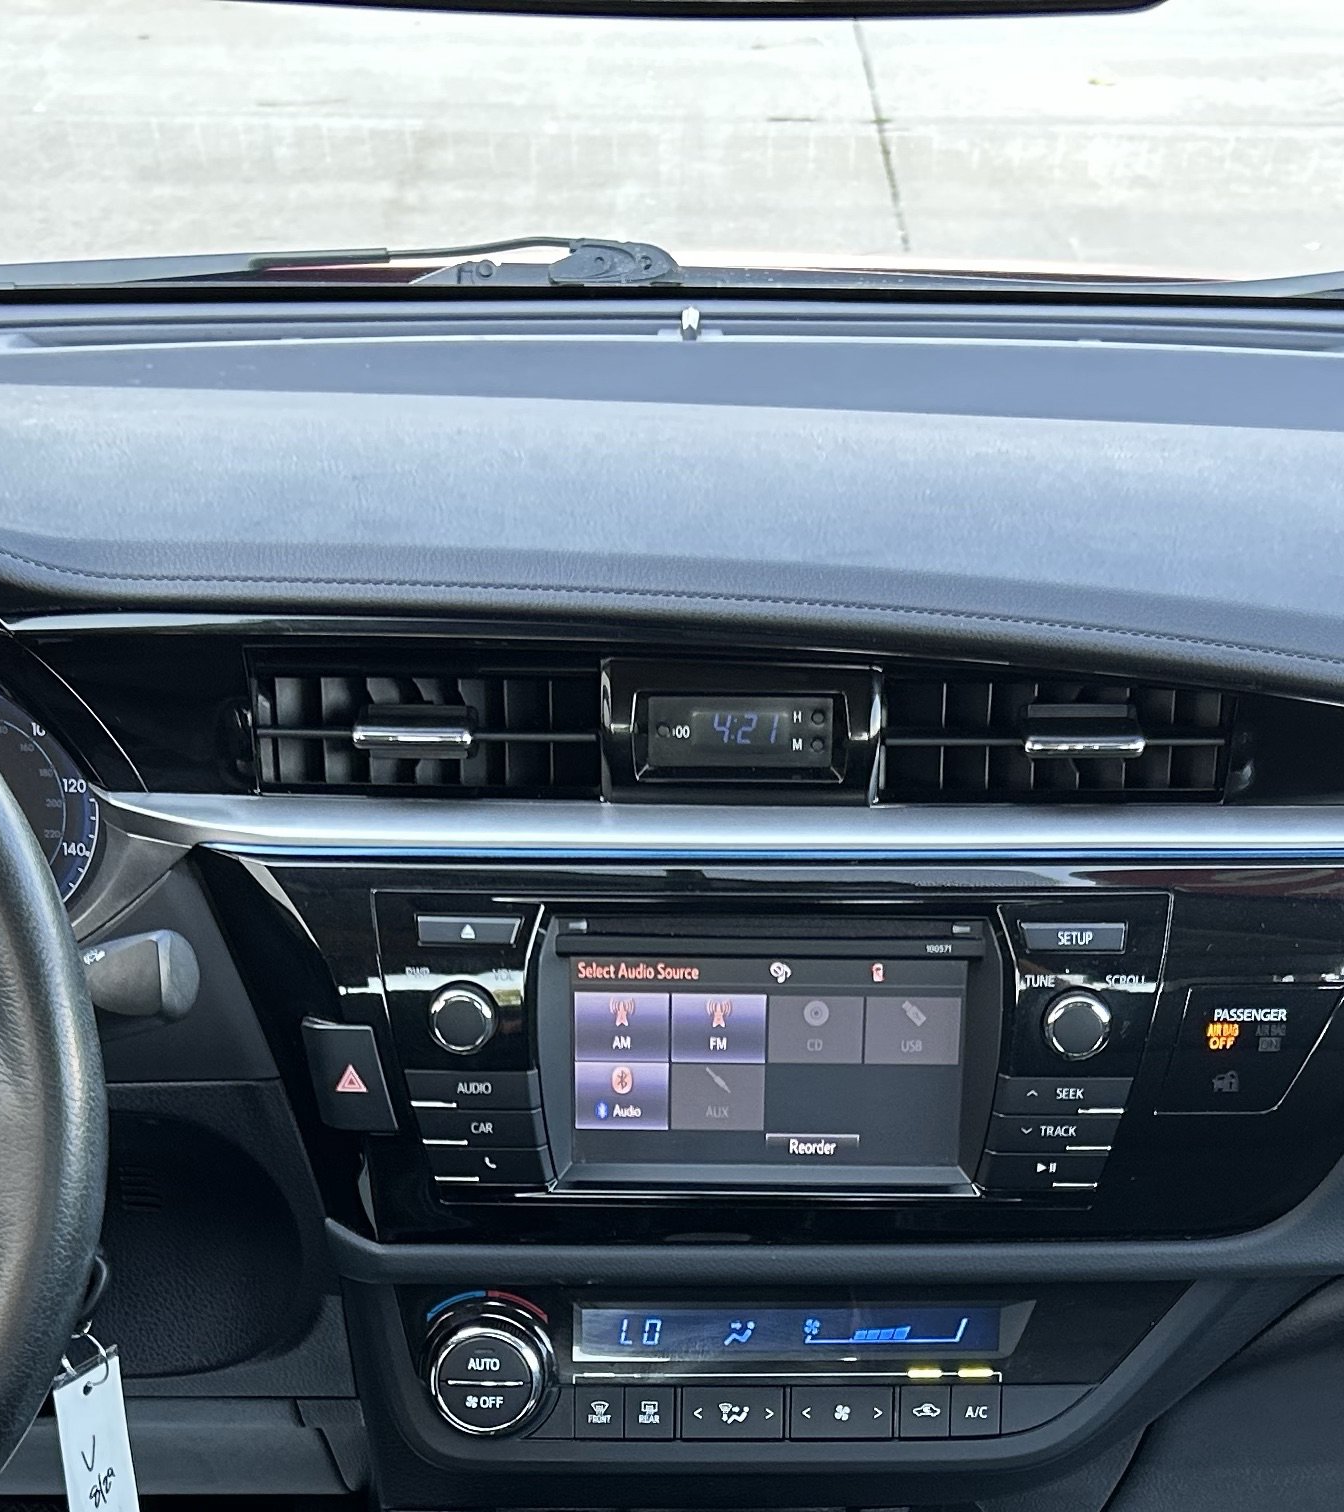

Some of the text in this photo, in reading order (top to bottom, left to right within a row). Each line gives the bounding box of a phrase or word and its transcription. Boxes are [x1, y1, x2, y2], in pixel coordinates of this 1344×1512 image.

[793, 710, 802, 723] H
[713, 712, 780, 745] 4:21
[792, 738, 803, 751] M
[63, 778, 86, 794] 120
[63, 842, 86, 857] 140
[1057, 931, 1094, 946] SETUP
[578, 962, 699, 980] Select Audio Source
[1025, 974, 1056, 988] TUNE
[1214, 1008, 1287, 1021] PASSENGER
[612, 1035, 631, 1050] AM
[709, 1037, 727, 1051] FM
[807, 1039, 823, 1052] CD
[901, 1040, 923, 1053] USB
[1209, 1036, 1235, 1050] OFF
[457, 1082, 491, 1094] AUDIO
[1056, 1087, 1084, 1100] SEEK
[613, 1103, 642, 1118] Audio
[706, 1106, 729, 1118] AUX
[471, 1122, 493, 1134] CAR
[1040, 1125, 1076, 1138] TRACK
[789, 1138, 837, 1155] Reorder
[467, 1358, 500, 1371] AUTO
[479, 1396, 504, 1409] OFF
[965, 1406, 988, 1418] A/C
[587, 1415, 612, 1424] FRONT
[638, 1415, 661, 1424] REAR
